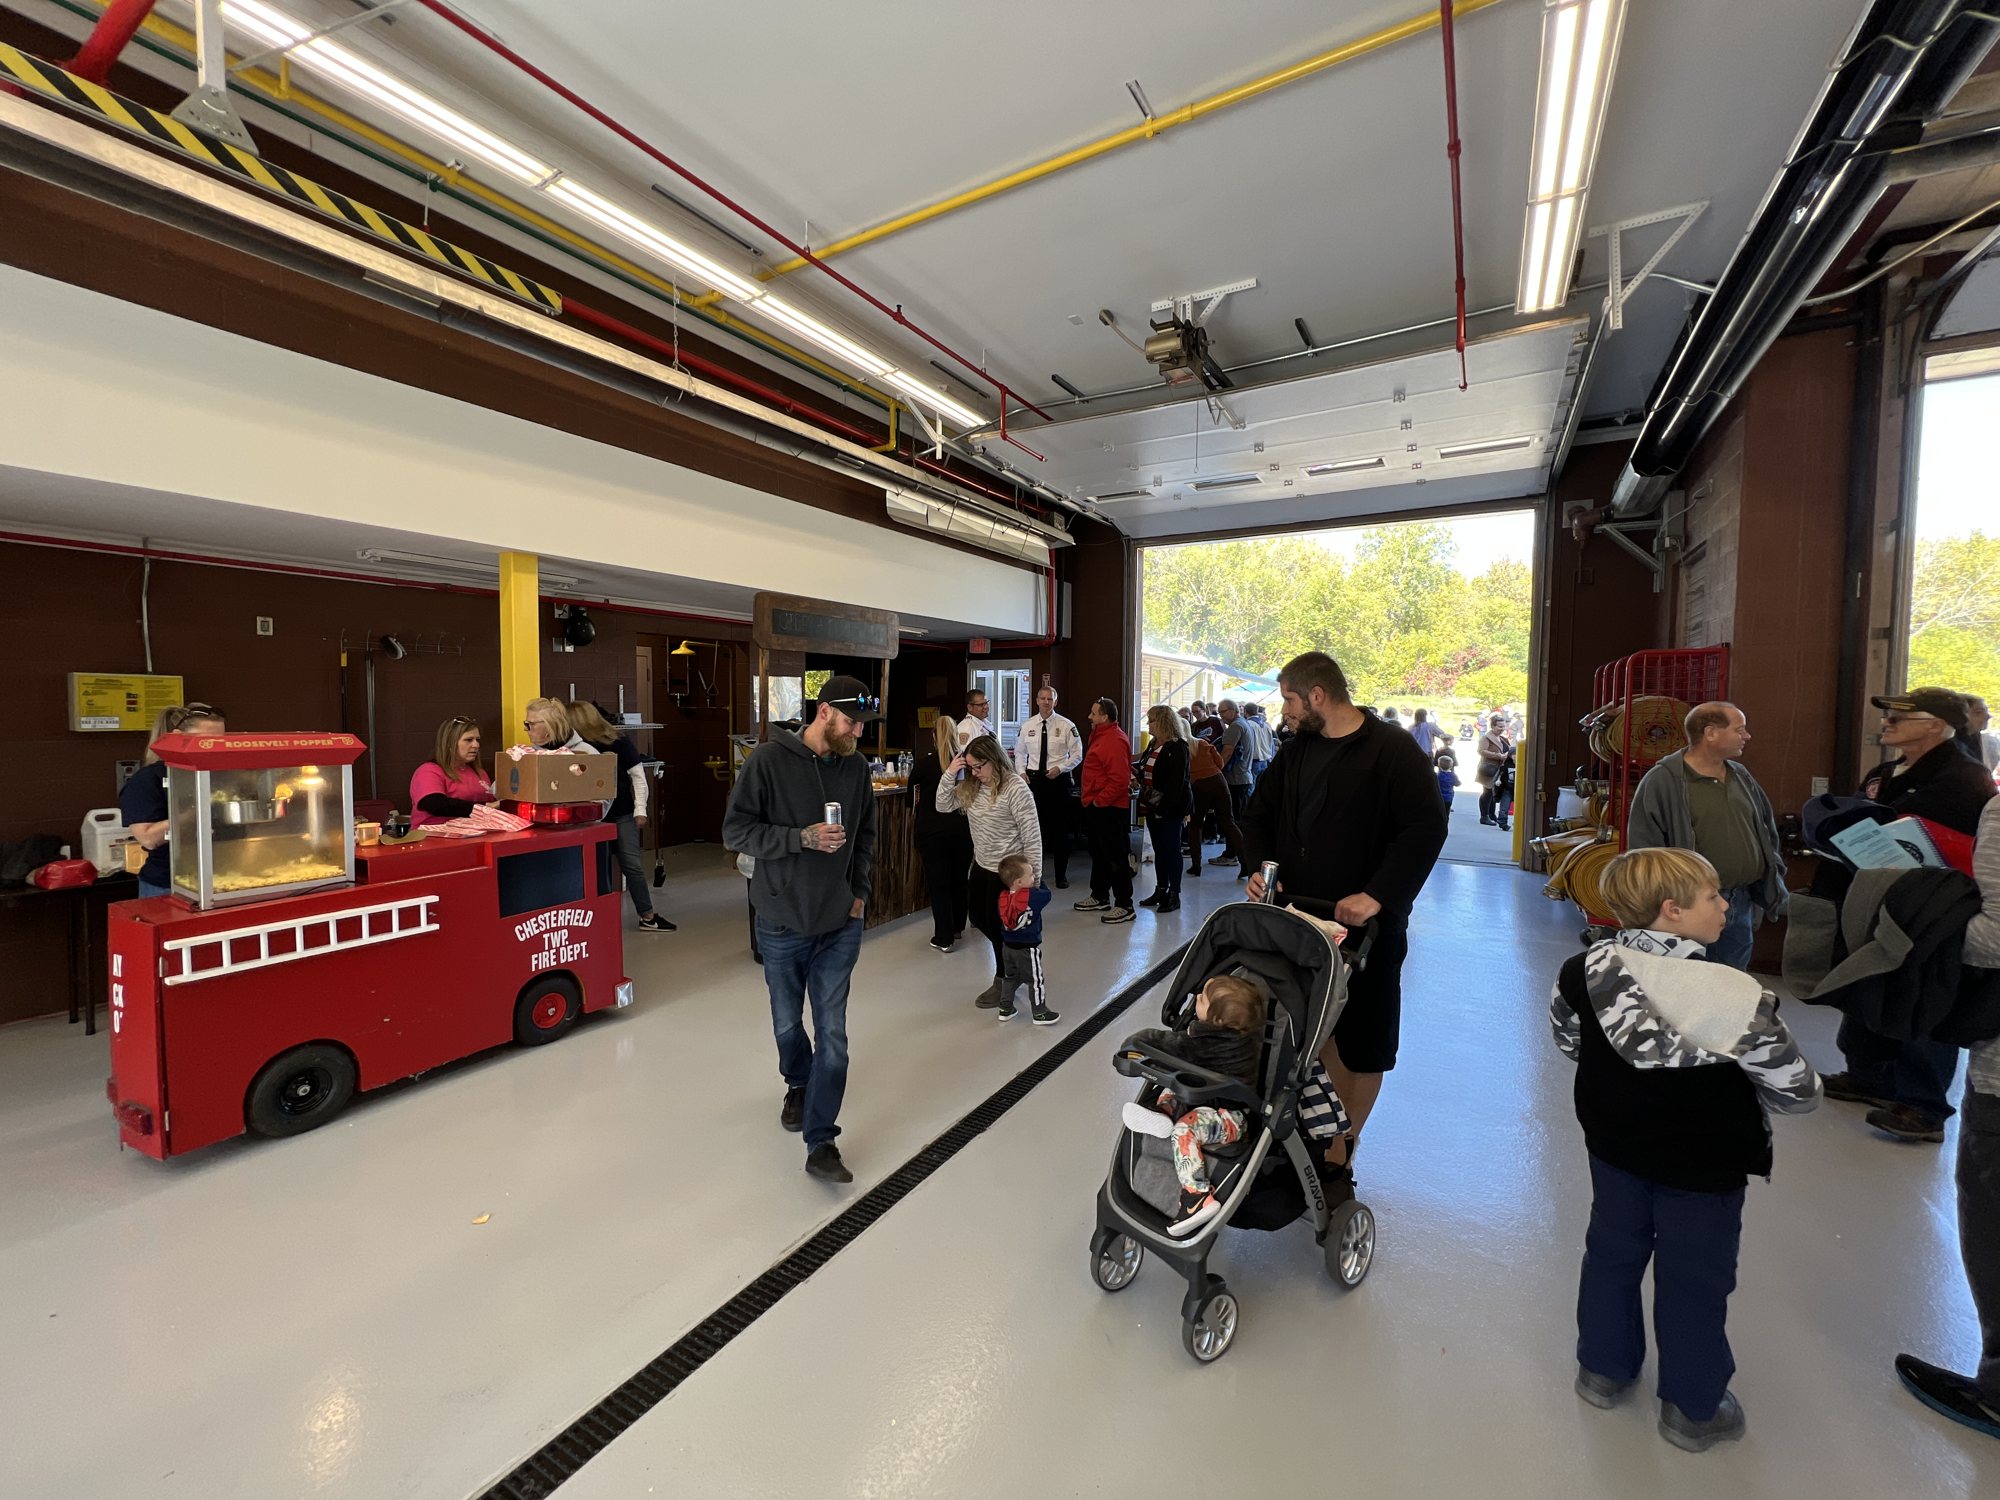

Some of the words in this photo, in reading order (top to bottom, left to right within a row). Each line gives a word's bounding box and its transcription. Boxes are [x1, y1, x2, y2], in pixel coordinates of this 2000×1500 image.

[225, 740, 289, 748] ROOSEVELT
[514, 908, 594, 942] CHESTERFIELD
[543, 928, 569, 950] TWP.
[531, 949, 557, 972] FIRE
[560, 941, 589, 964] DEPT.
[1303, 1165, 1324, 1211] BRAVO
